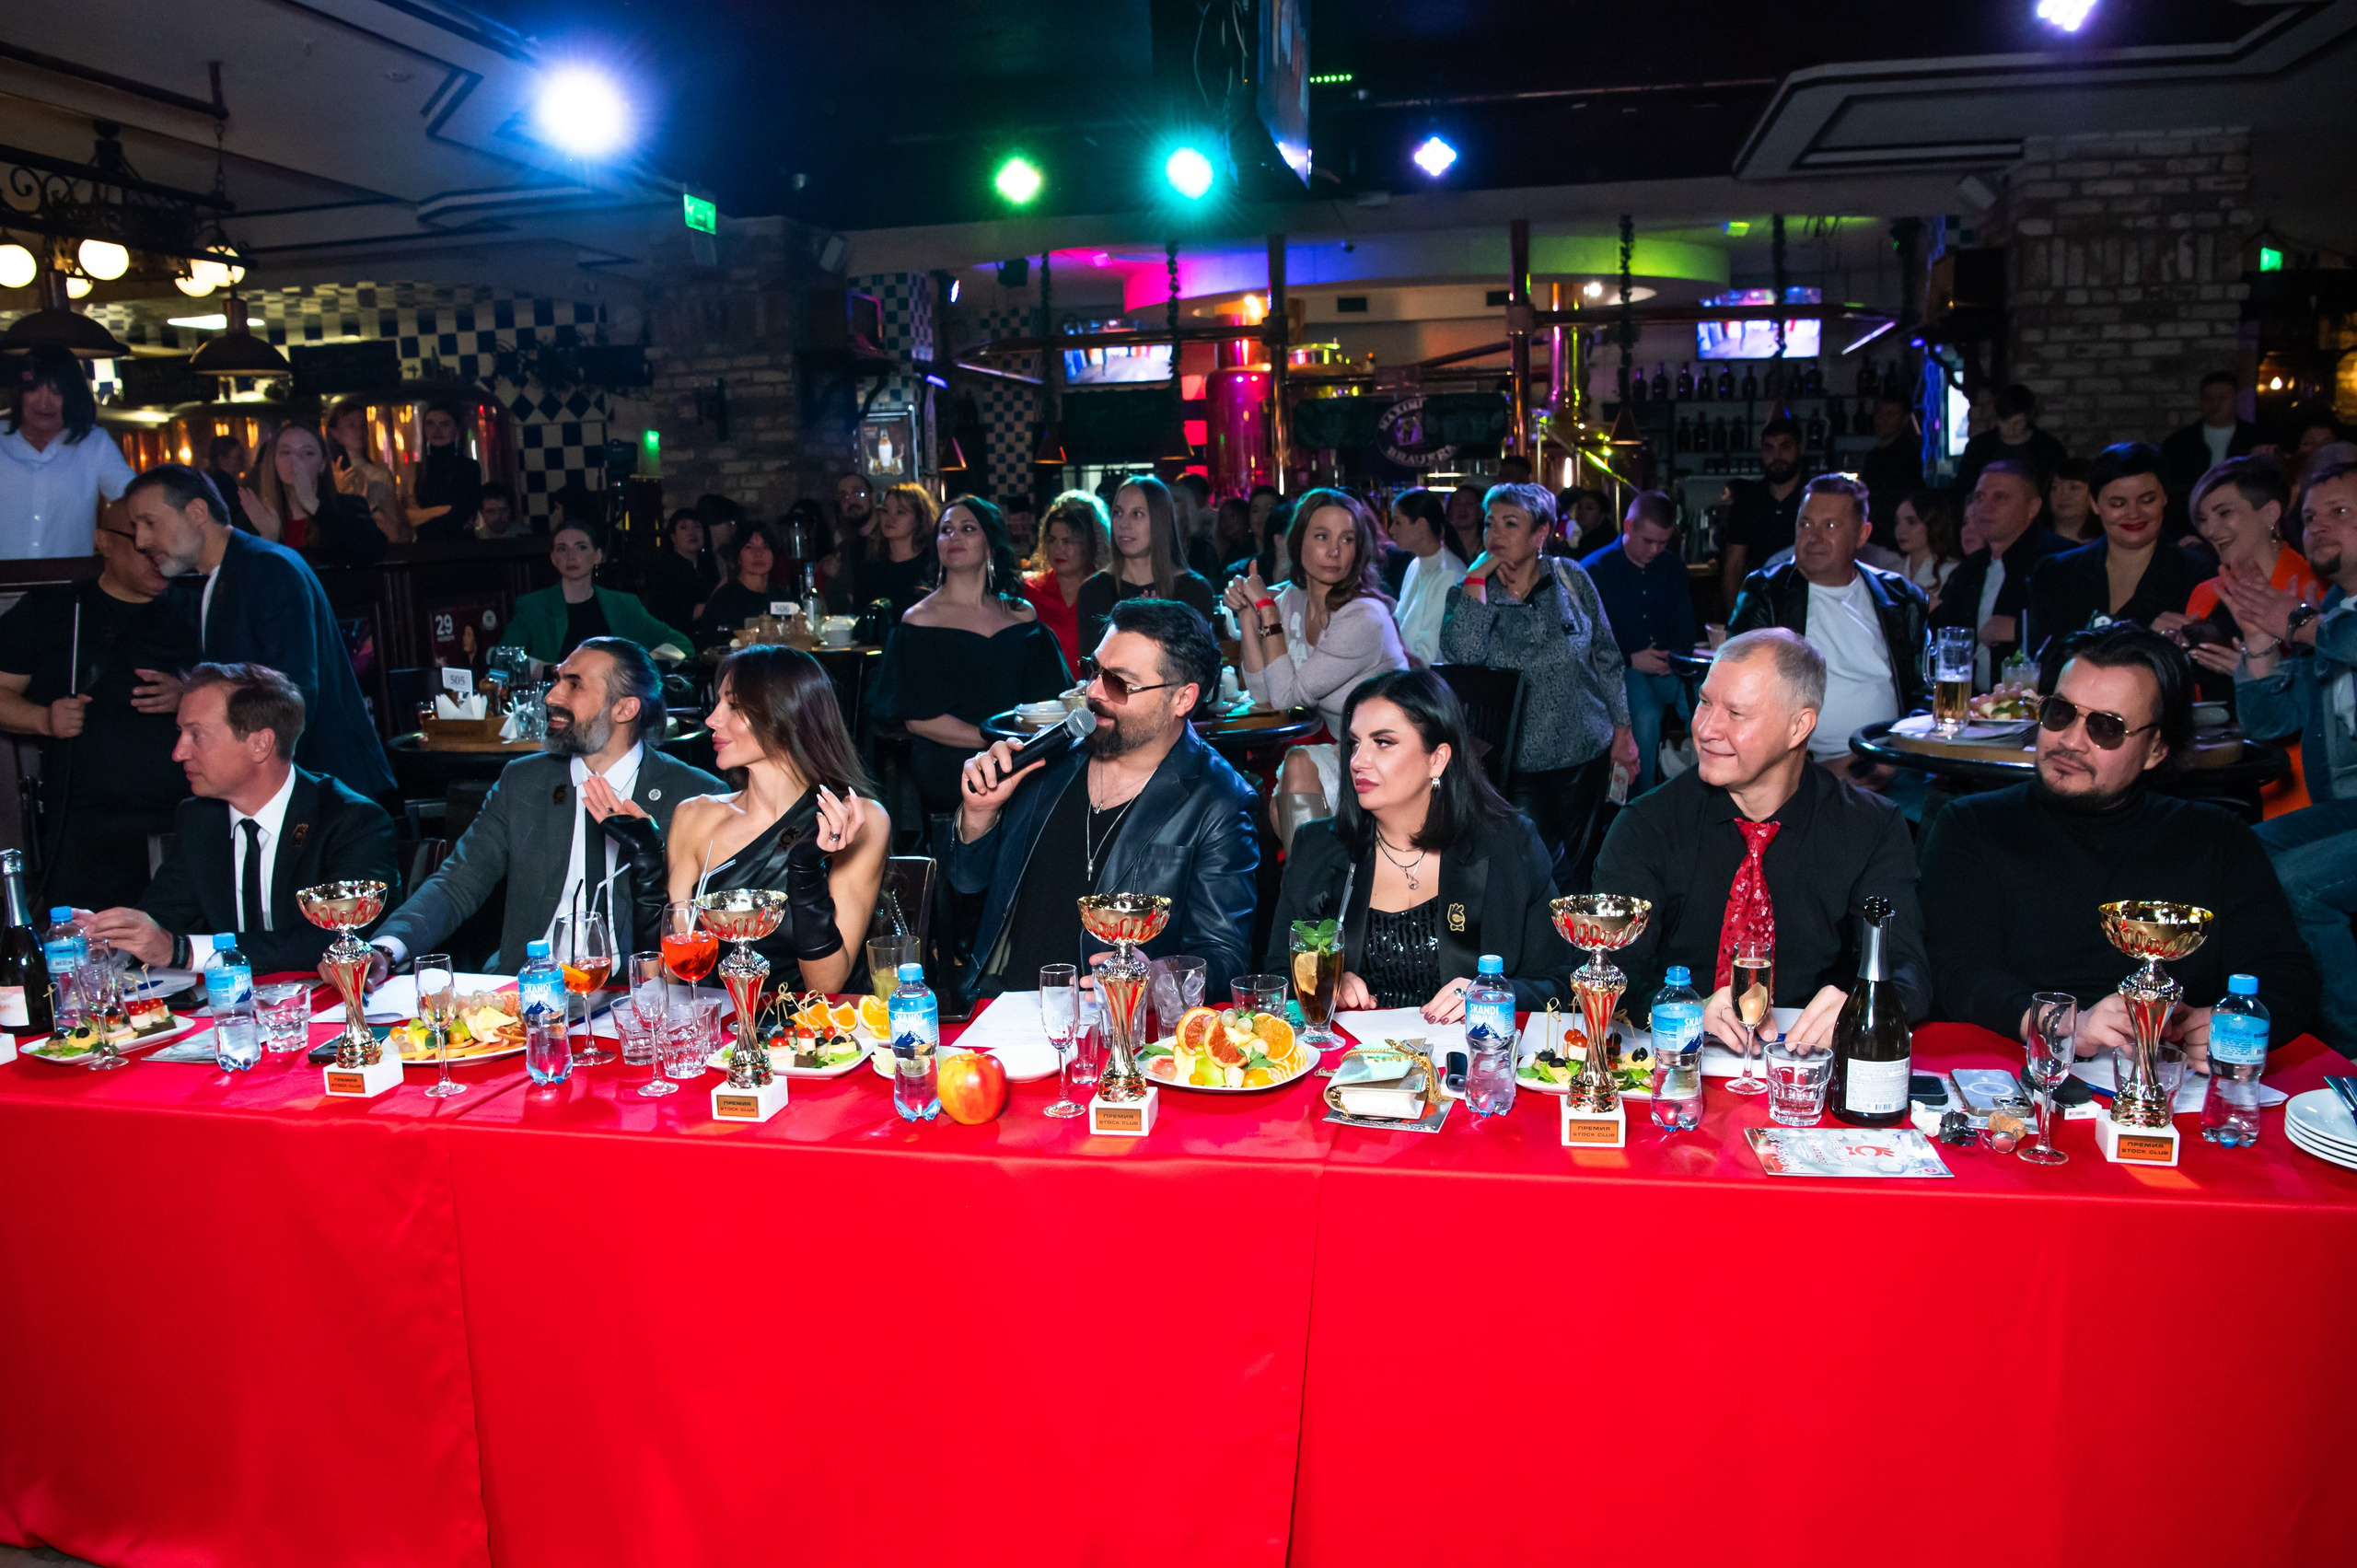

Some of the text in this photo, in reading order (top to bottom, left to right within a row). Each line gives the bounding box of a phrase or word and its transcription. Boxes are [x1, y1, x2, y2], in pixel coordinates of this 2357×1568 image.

[435, 614, 453, 635] 29
[449, 675, 465, 686] 505
[524, 983, 552, 993] SKANDI
[1470, 1004, 1499, 1015] SKANDI
[894, 1013, 923, 1022] SKANDI
[1470, 1013, 1494, 1024] NAVIA
